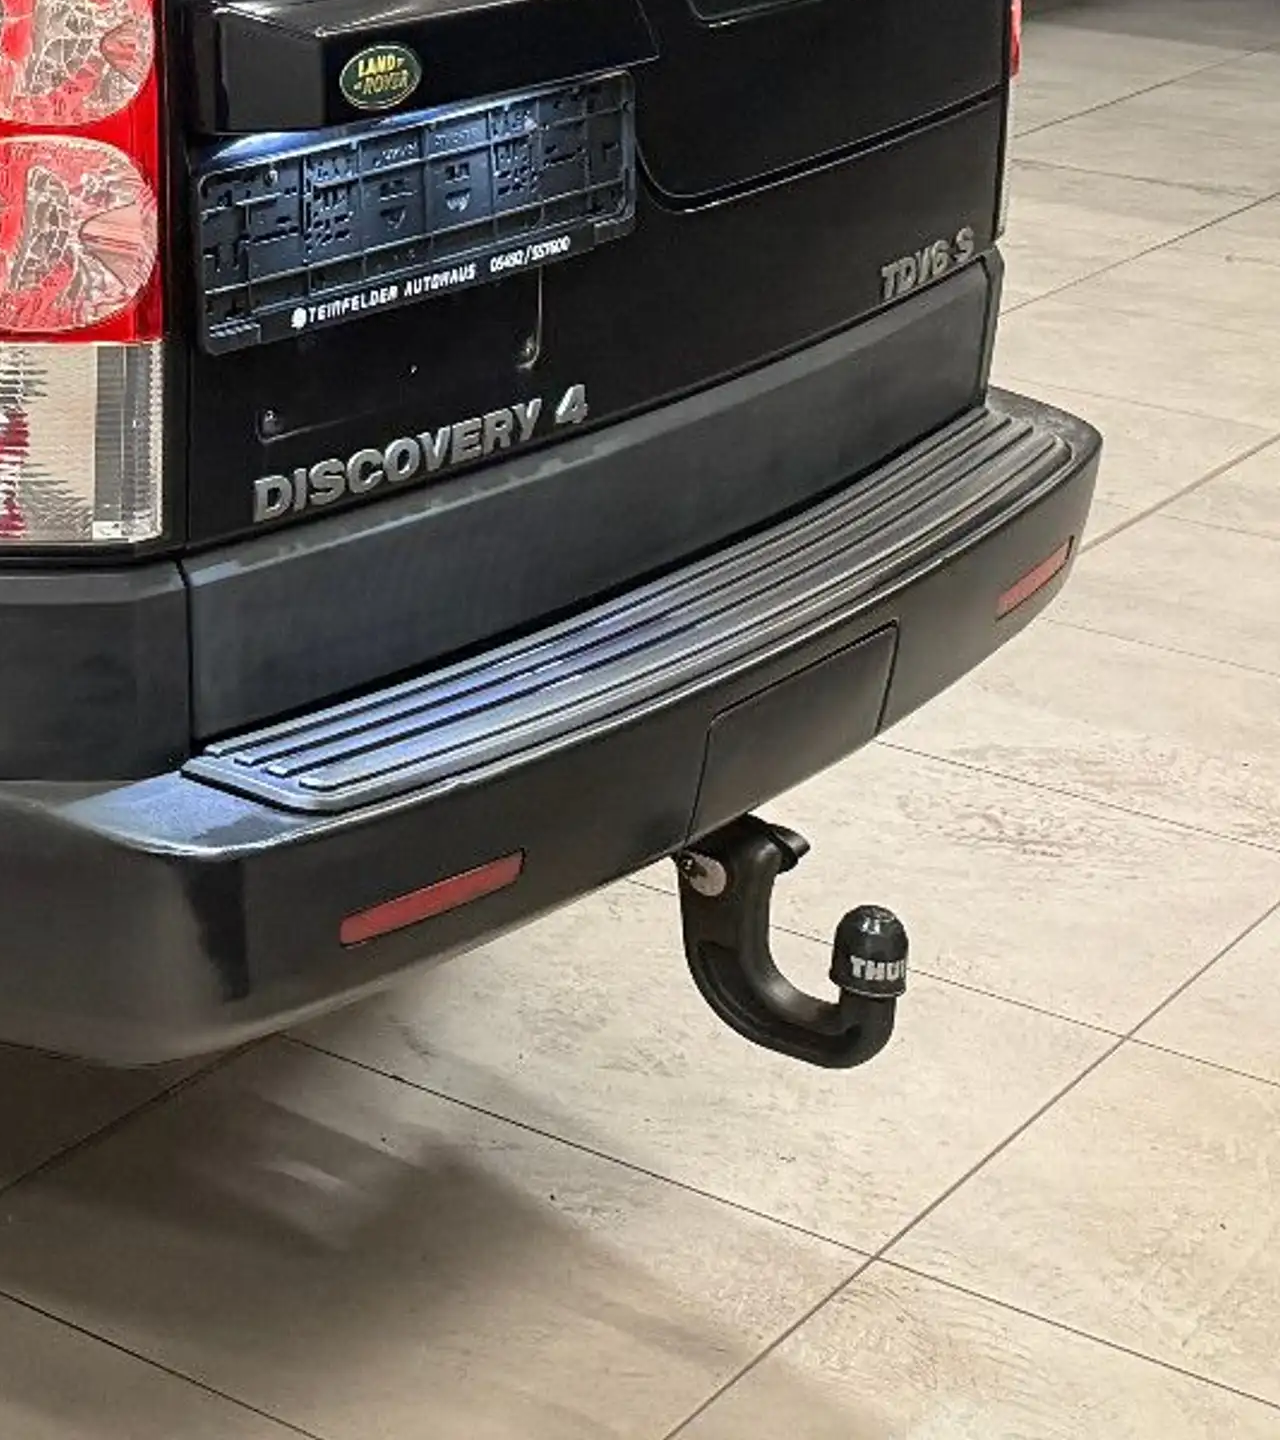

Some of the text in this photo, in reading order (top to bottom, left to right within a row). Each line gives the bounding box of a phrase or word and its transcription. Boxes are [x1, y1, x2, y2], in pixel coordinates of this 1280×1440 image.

[358, 53, 397, 78] LAND
[403, 263, 477, 297] AUTOHAUS
[254, 383, 589, 523] DISCOVERY 4
